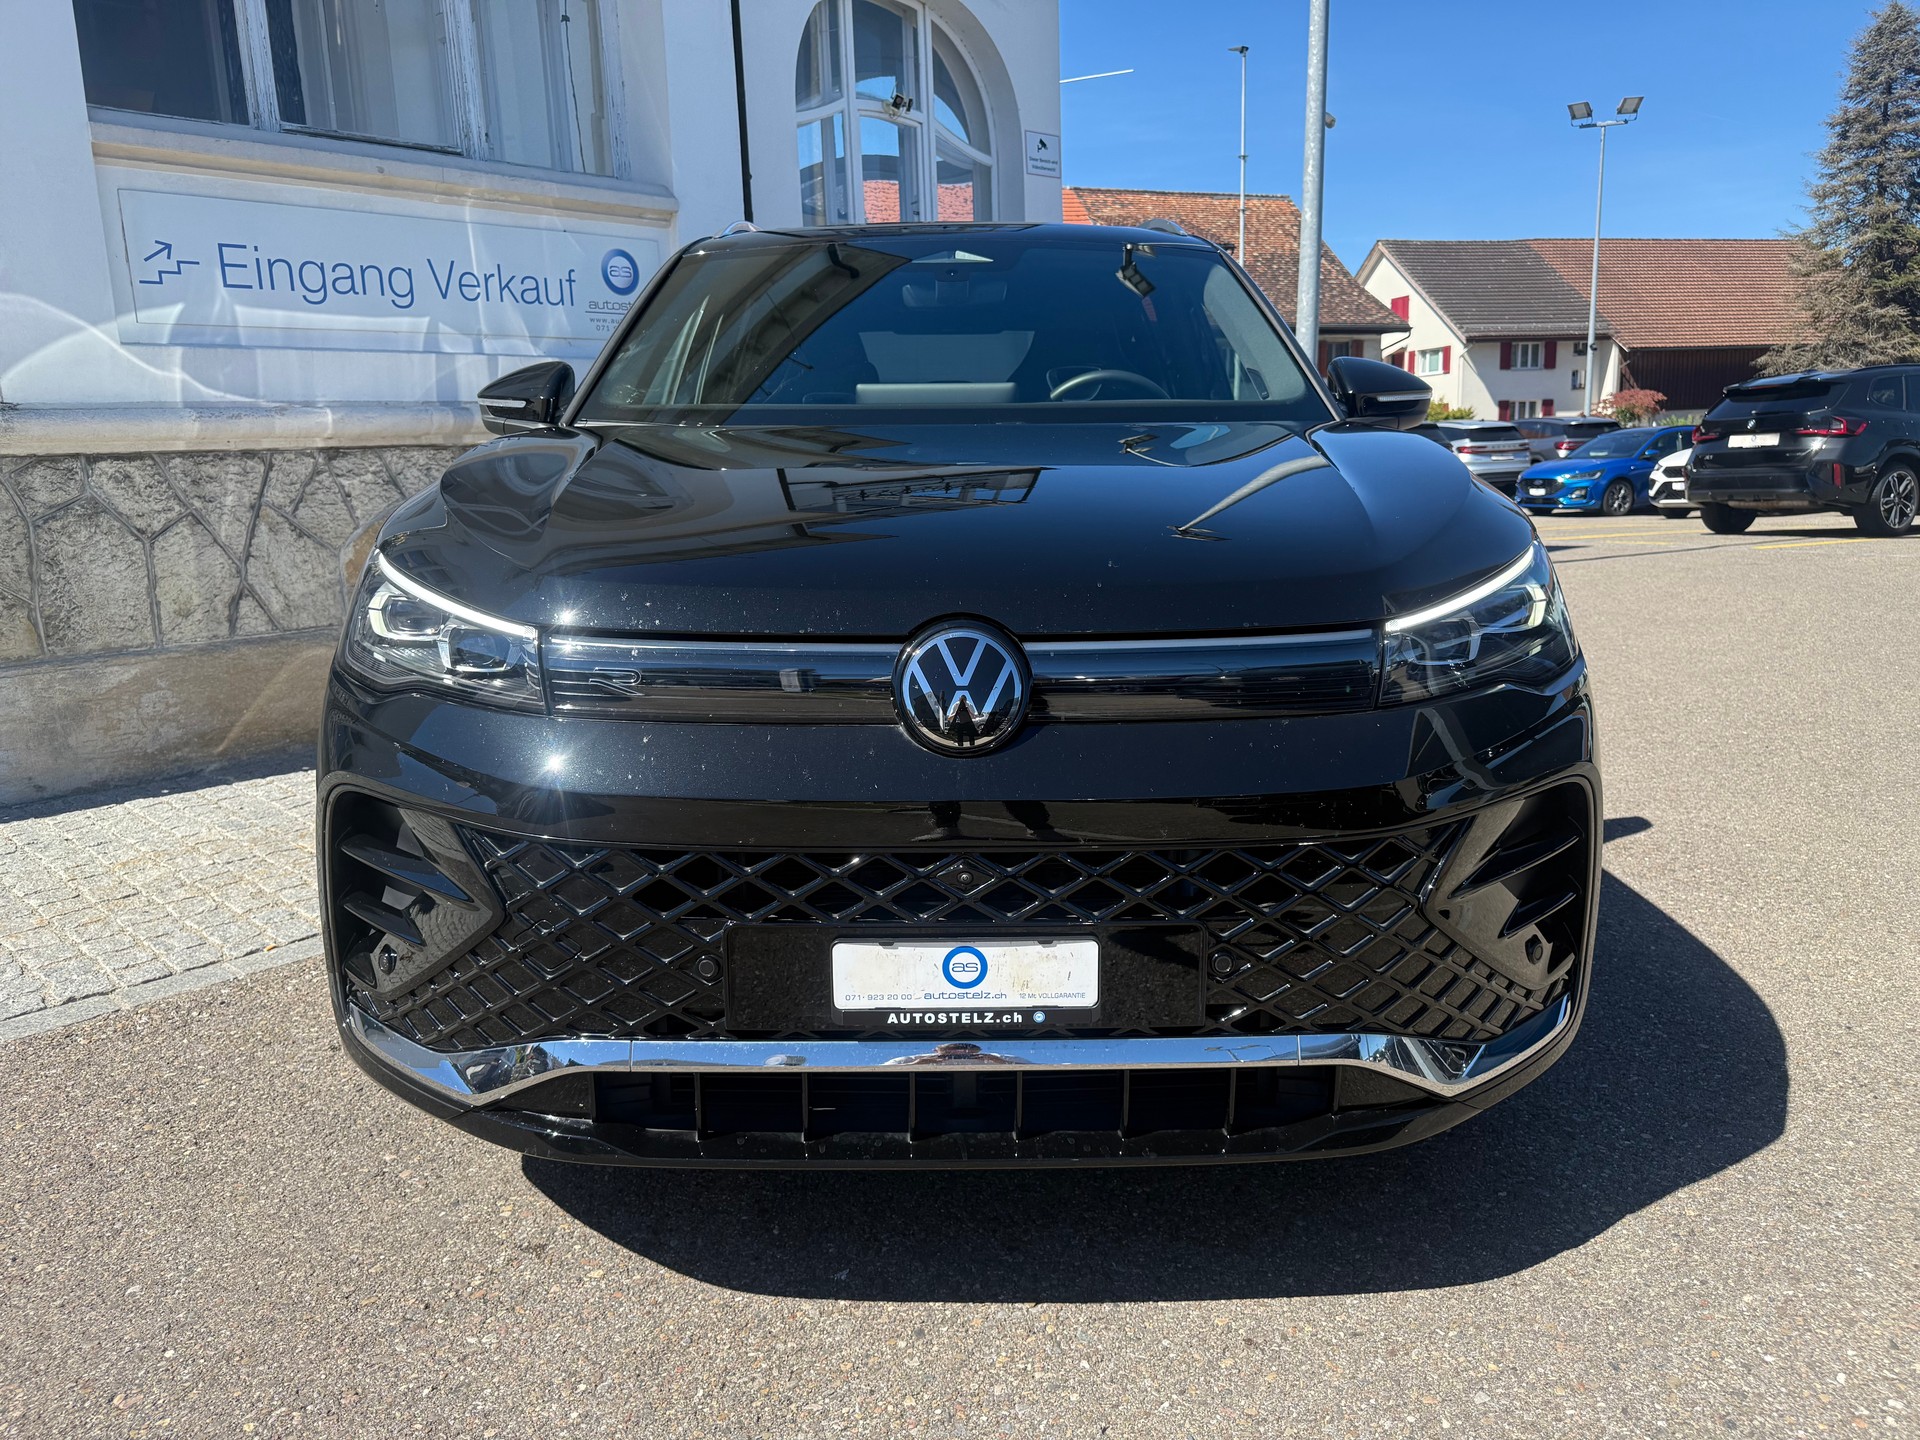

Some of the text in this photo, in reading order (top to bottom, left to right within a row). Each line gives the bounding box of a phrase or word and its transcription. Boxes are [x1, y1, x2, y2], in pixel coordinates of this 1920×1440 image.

[216, 242, 576, 309] Eingang Verkauf
[609, 265, 632, 278] as
[951, 962, 979, 973] as
[867, 993, 885, 1001] 923
[887, 993, 899, 1001] 20
[900, 993, 913, 1001] 00
[923, 990, 1007, 1000] autostelz.ch
[887, 1012, 1023, 1024] AUTOSTELZ.ch
